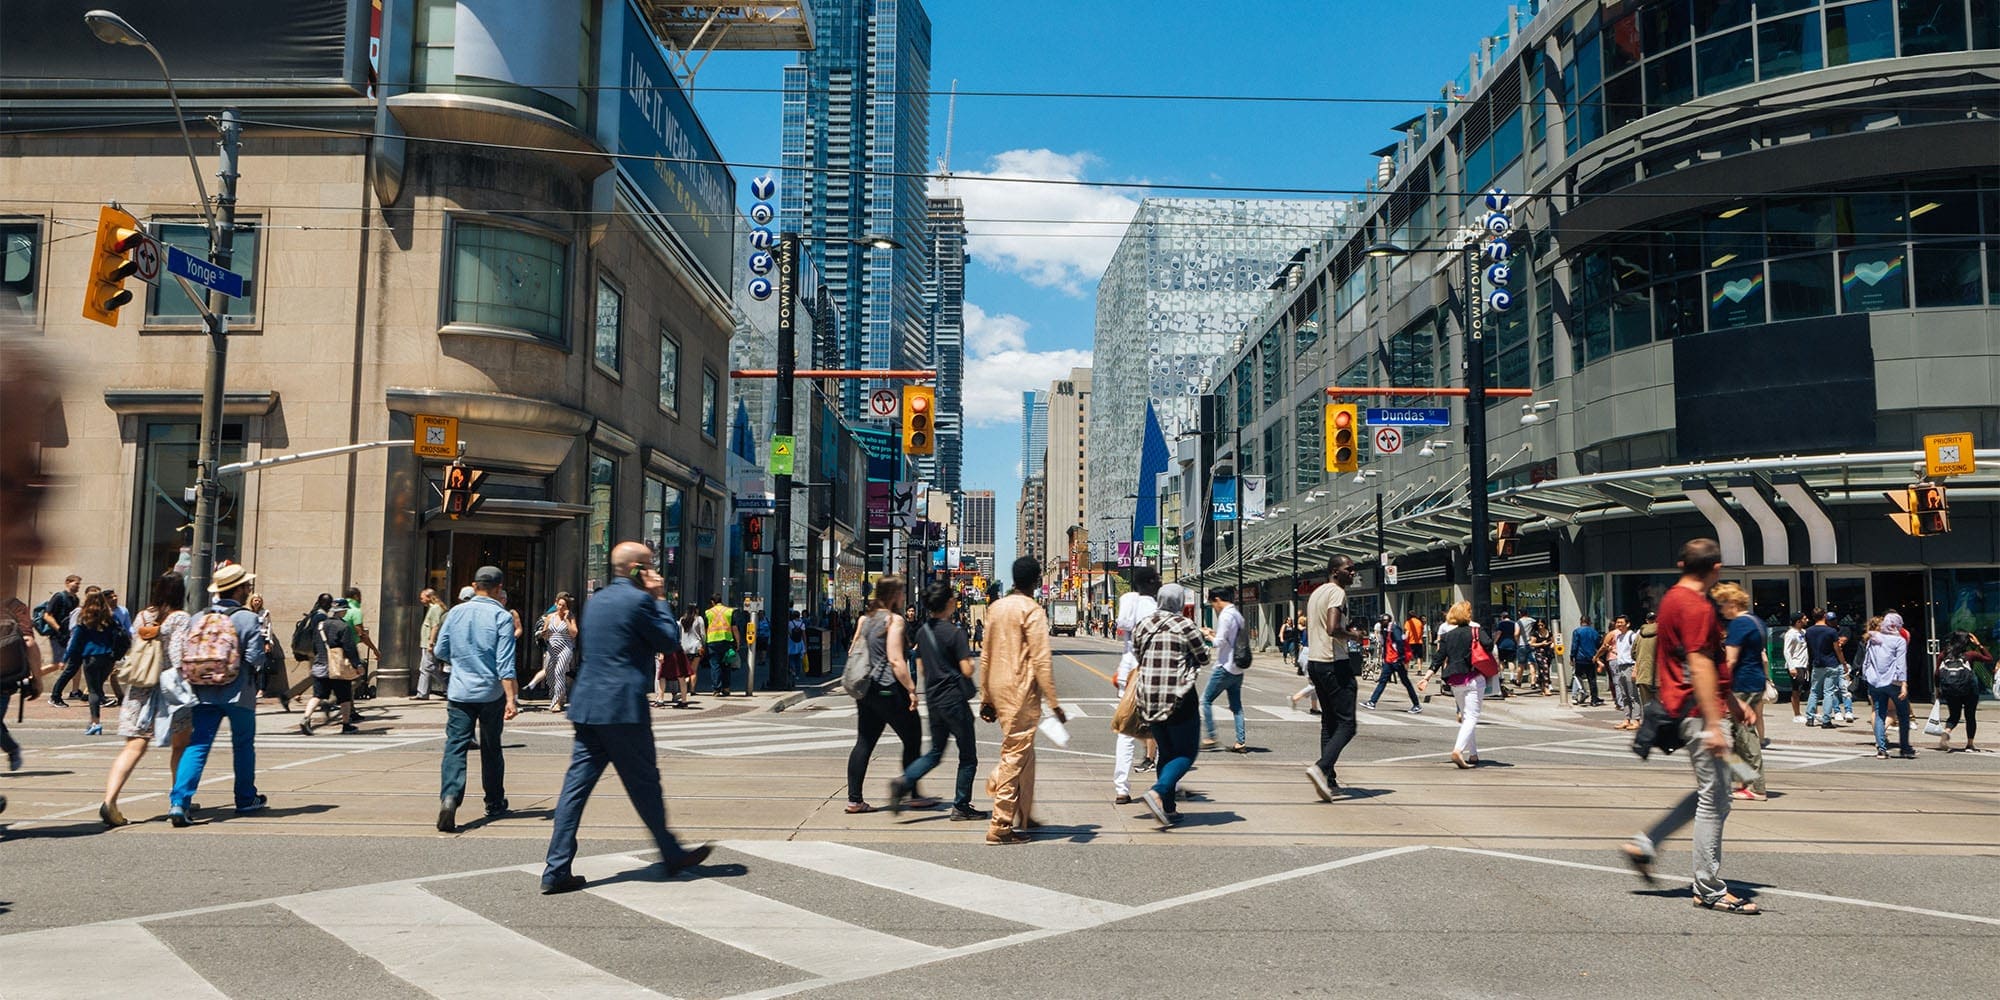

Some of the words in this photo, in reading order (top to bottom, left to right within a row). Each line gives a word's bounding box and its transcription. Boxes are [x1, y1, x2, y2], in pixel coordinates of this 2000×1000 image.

[629, 51, 653, 122] LIKE
[652, 90, 663, 138] IT.
[665, 105, 688, 175] WEAR
[688, 144, 698, 187] IT.
[699, 163, 721, 221] SHARE
[748, 176, 775, 301] Yonge
[186, 256, 217, 285] Yonge
[218, 270, 225, 280] St
[781, 240, 792, 328] DOWNTOWN
[1471, 252, 1482, 339] DOWNTOWN
[423, 417, 450, 425] PRIORITY
[1381, 410, 1425, 421] Dundas
[420, 445, 451, 453] CROSSING
[1933, 436, 1963, 445] PRIORITY
[1934, 464, 1968, 473] CROSSING
